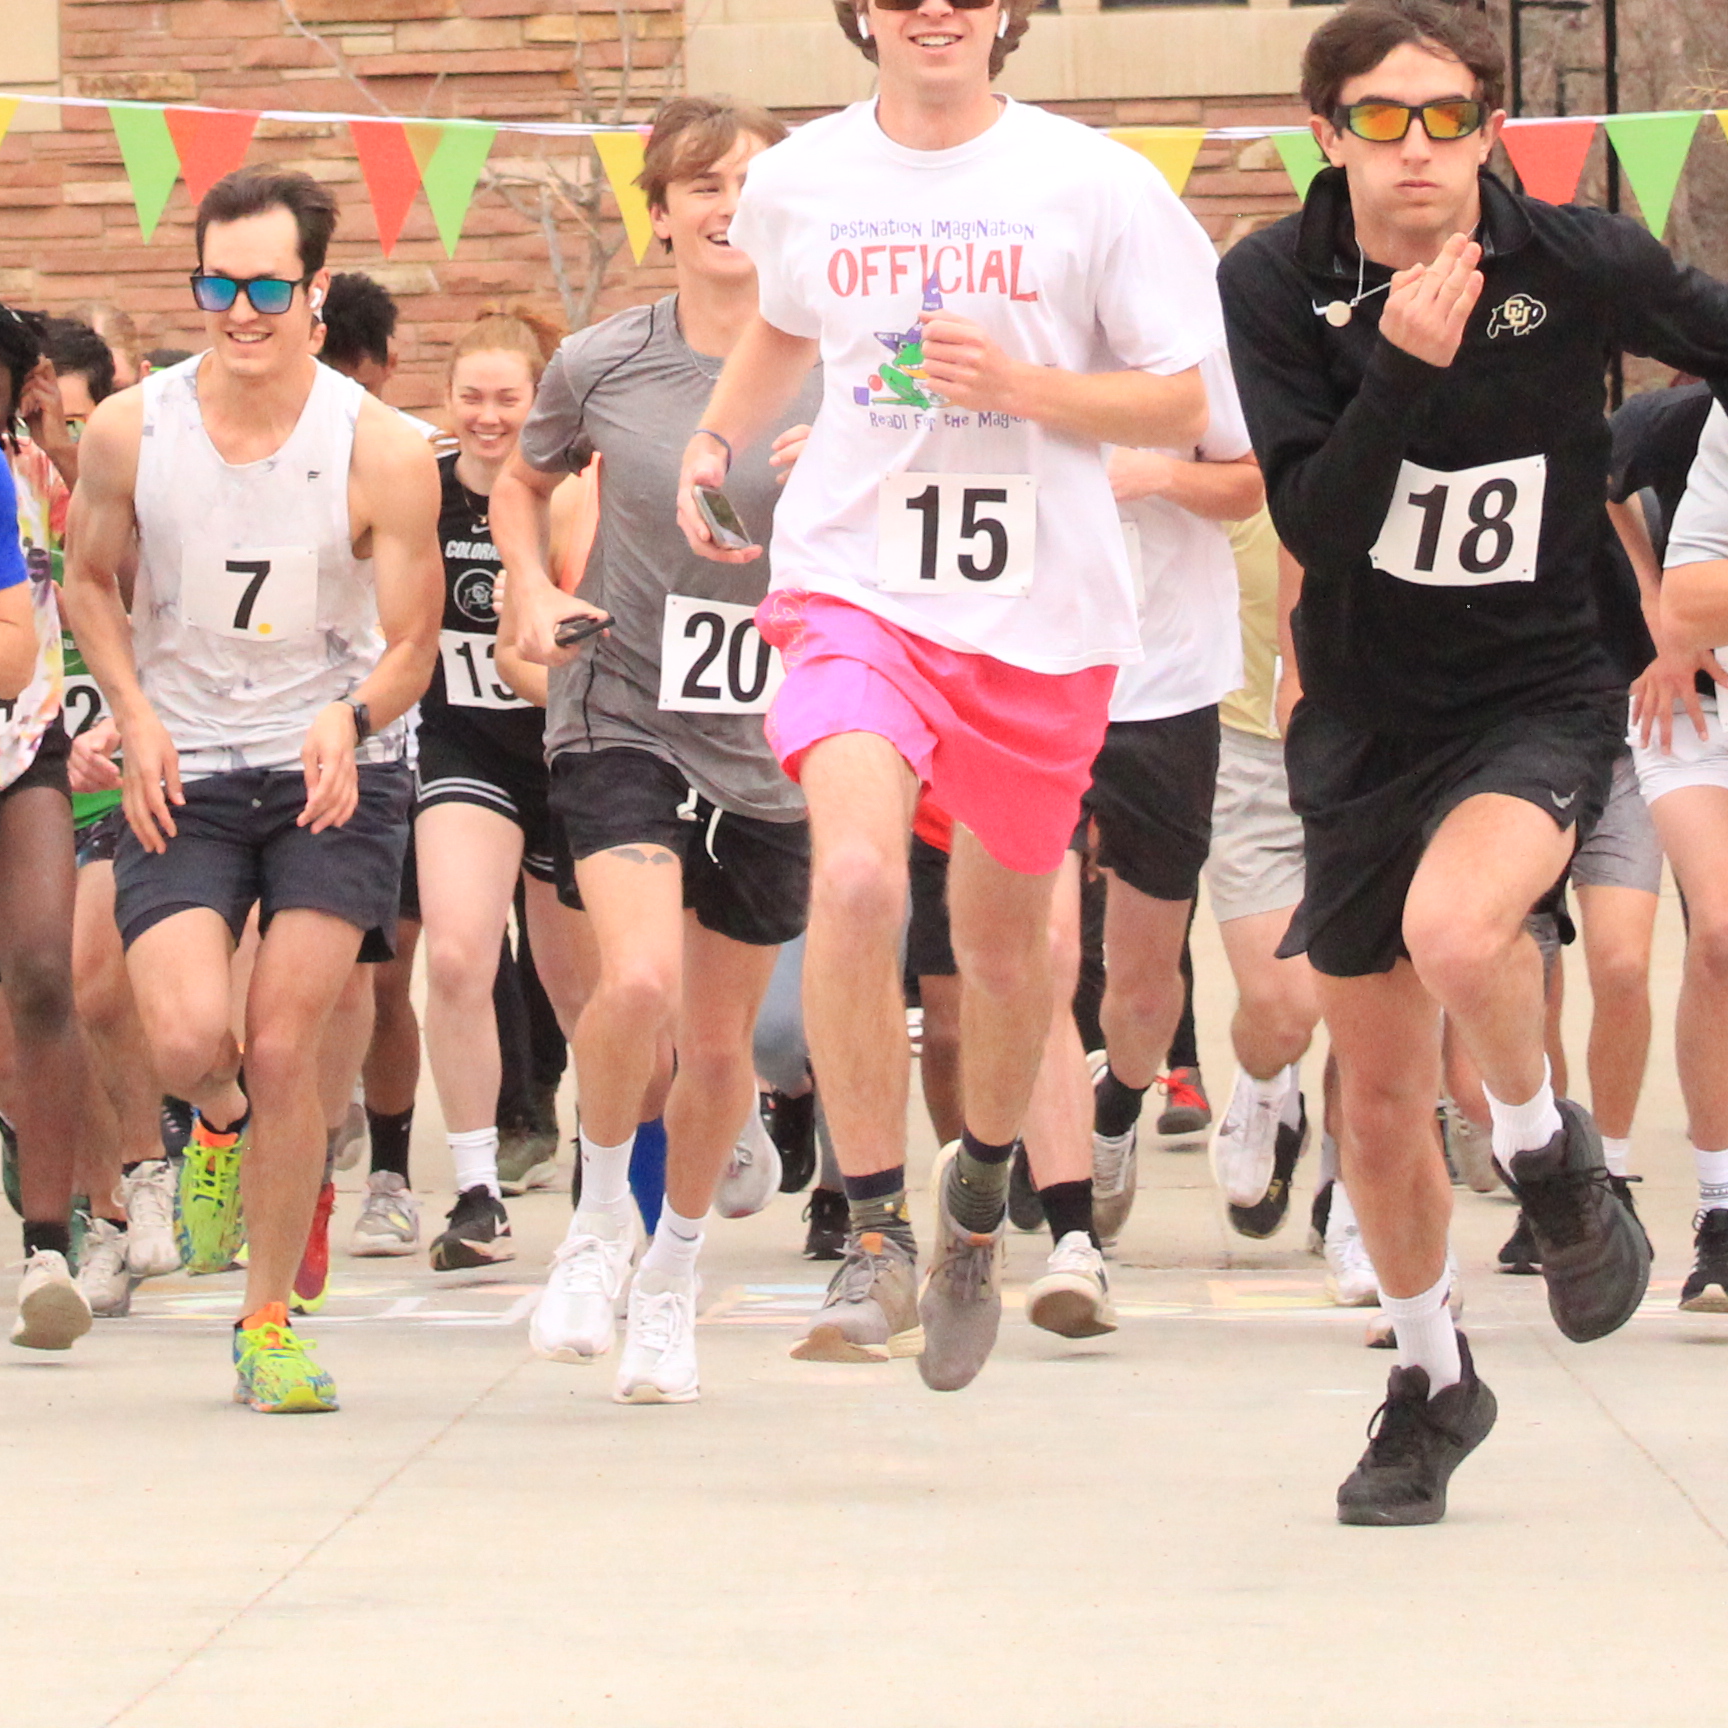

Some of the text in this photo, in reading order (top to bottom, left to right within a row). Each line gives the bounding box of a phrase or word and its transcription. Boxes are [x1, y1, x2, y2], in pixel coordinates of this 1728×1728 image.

[827, 242, 1038, 302] OFFICIAL
[907, 485, 1008, 581] 15
[1407, 478, 1518, 574] 18
[225, 560, 271, 630] 7
[681, 611, 772, 703] 20
